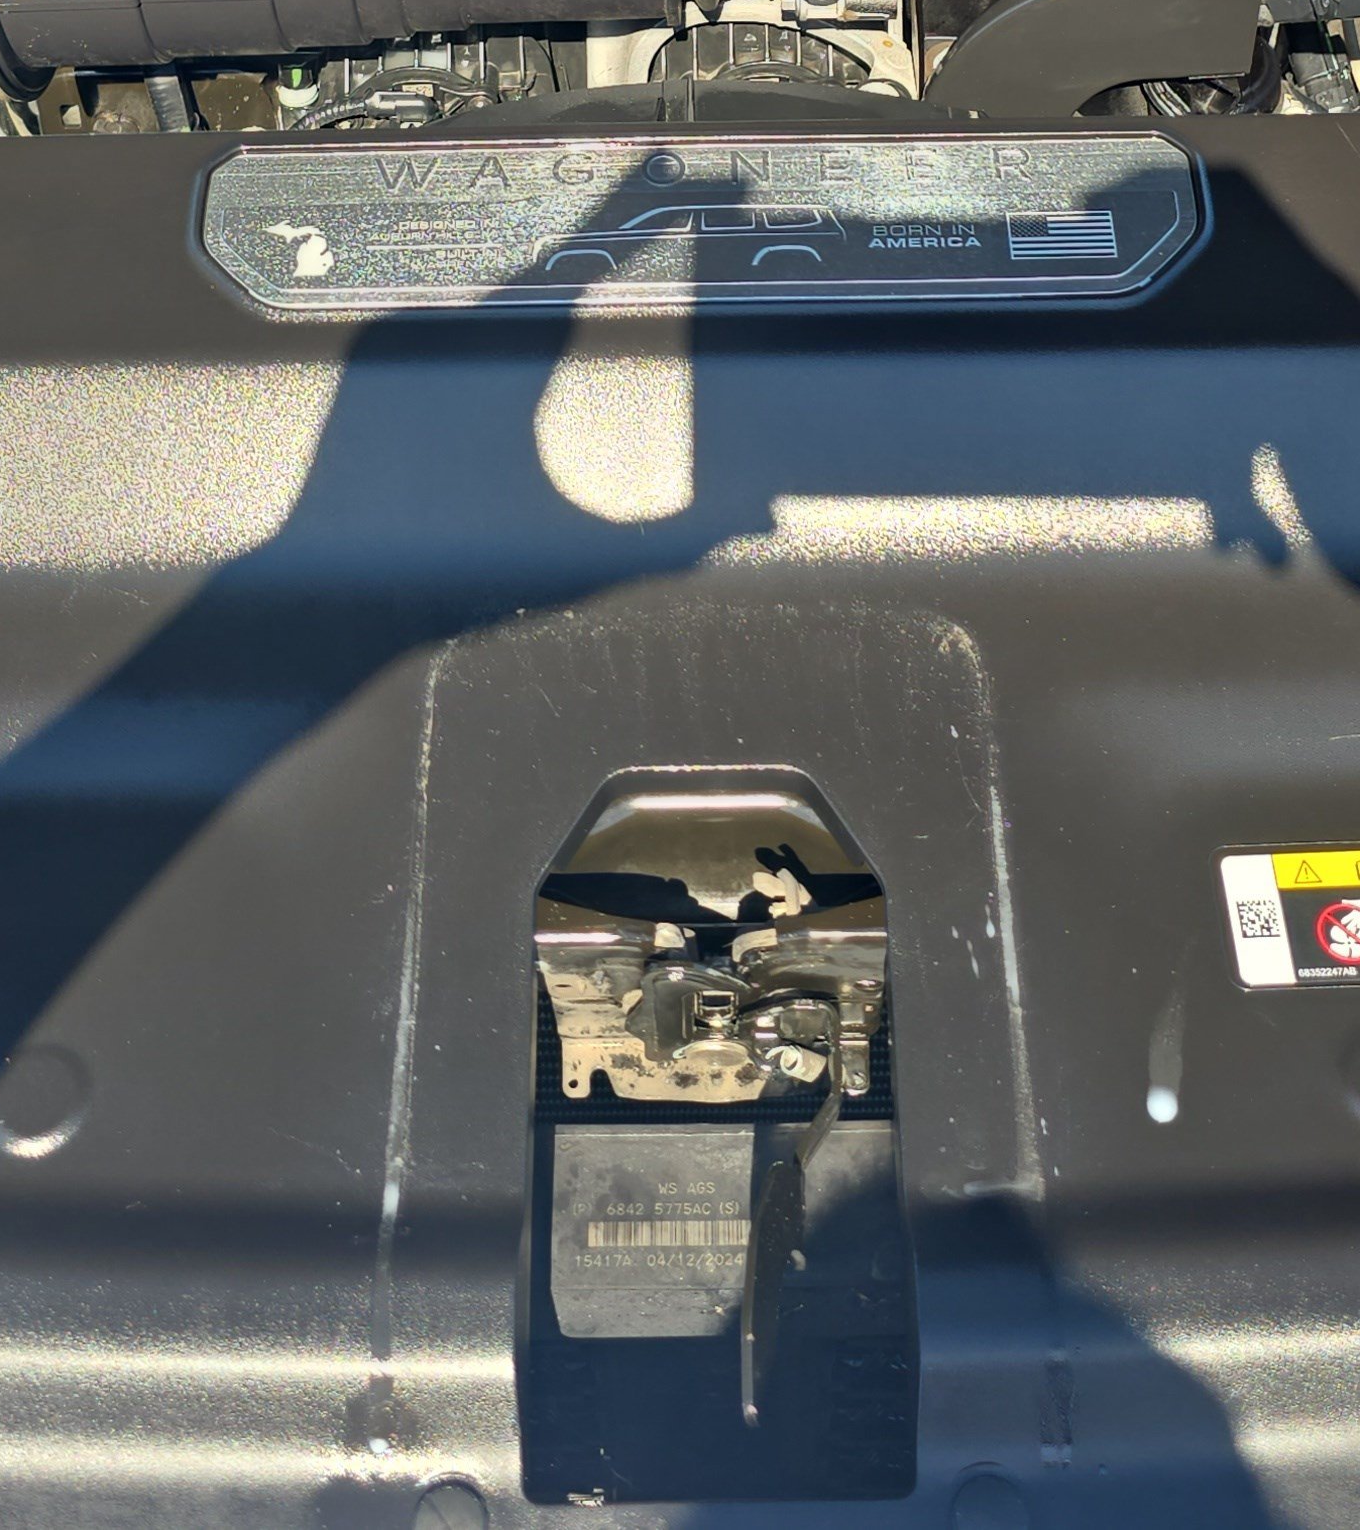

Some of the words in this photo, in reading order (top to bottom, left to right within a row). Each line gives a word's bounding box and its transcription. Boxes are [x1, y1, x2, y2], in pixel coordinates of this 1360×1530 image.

[375, 147, 1034, 192] WAGONEER
[872, 224, 941, 236] BORN
[951, 224, 976, 236] IN
[867, 236, 982, 248] AMERICA
[1298, 966, 1358, 978] 68352247AB
[658, 1182, 678, 1195] WS
[687, 1181, 717, 1194] AGS
[606, 1203, 645, 1216] 6842
[654, 1202, 712, 1215] 5775AC
[719, 1200, 741, 1215] (S)
[646, 1253, 745, 1267] 04/12/2024
